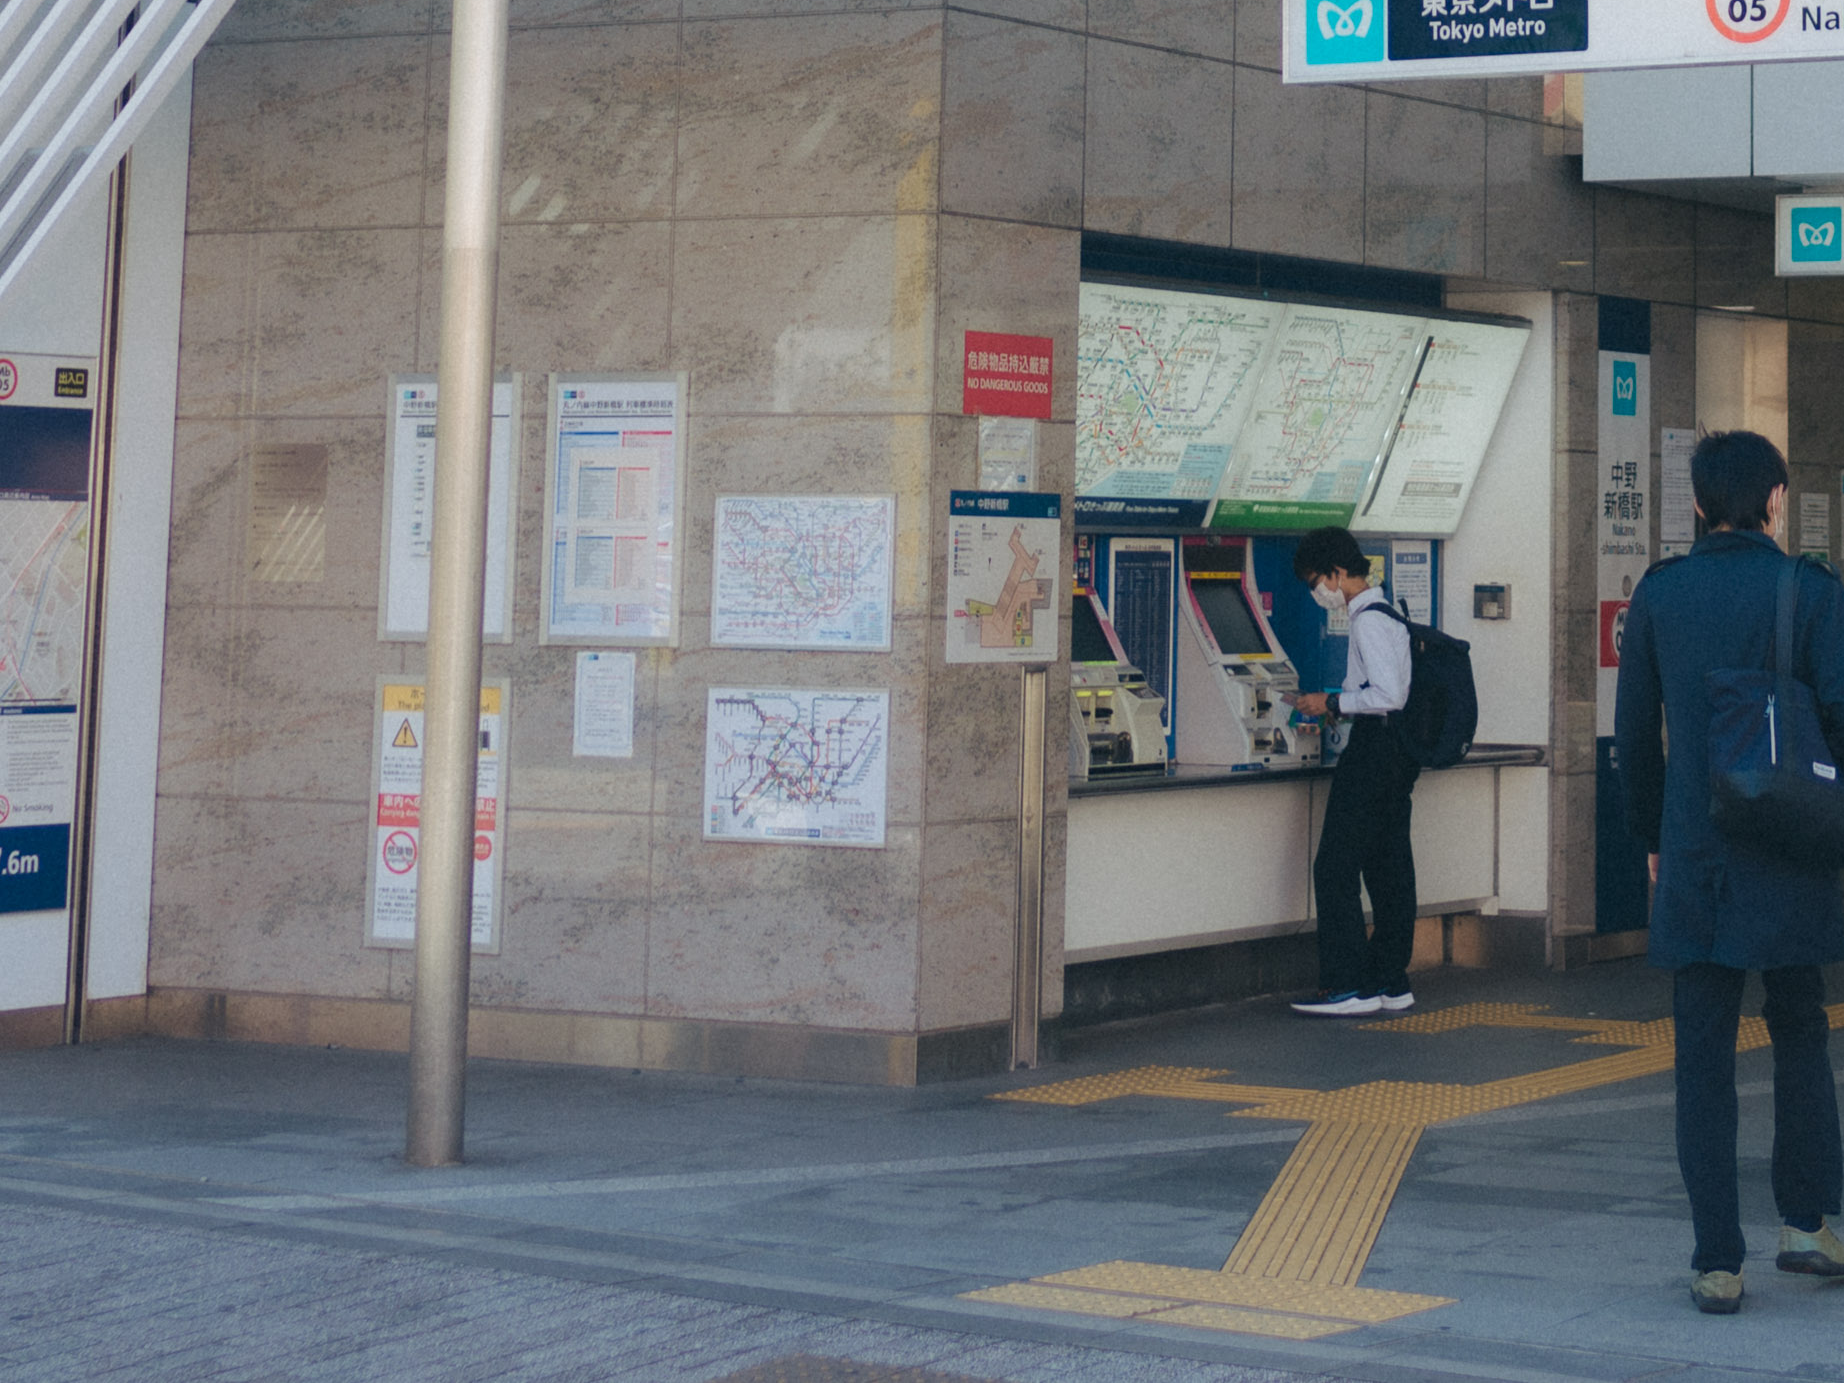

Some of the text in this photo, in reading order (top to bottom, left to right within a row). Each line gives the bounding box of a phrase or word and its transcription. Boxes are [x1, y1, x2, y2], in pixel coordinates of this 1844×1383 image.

[1429, 18, 1546, 43] Tokyo Metro
[968, 351, 1050, 375] 危険物品持込厳禁
[58, 372, 85, 385] 出入口
[967, 377, 1048, 394] NO DANGEROUS GOODS
[1611, 460, 1637, 490] 中野
[1604, 491, 1643, 521] 新橋駅
[1611, 523, 1636, 537] Nakano
[0, 846, 39, 875] .6m
